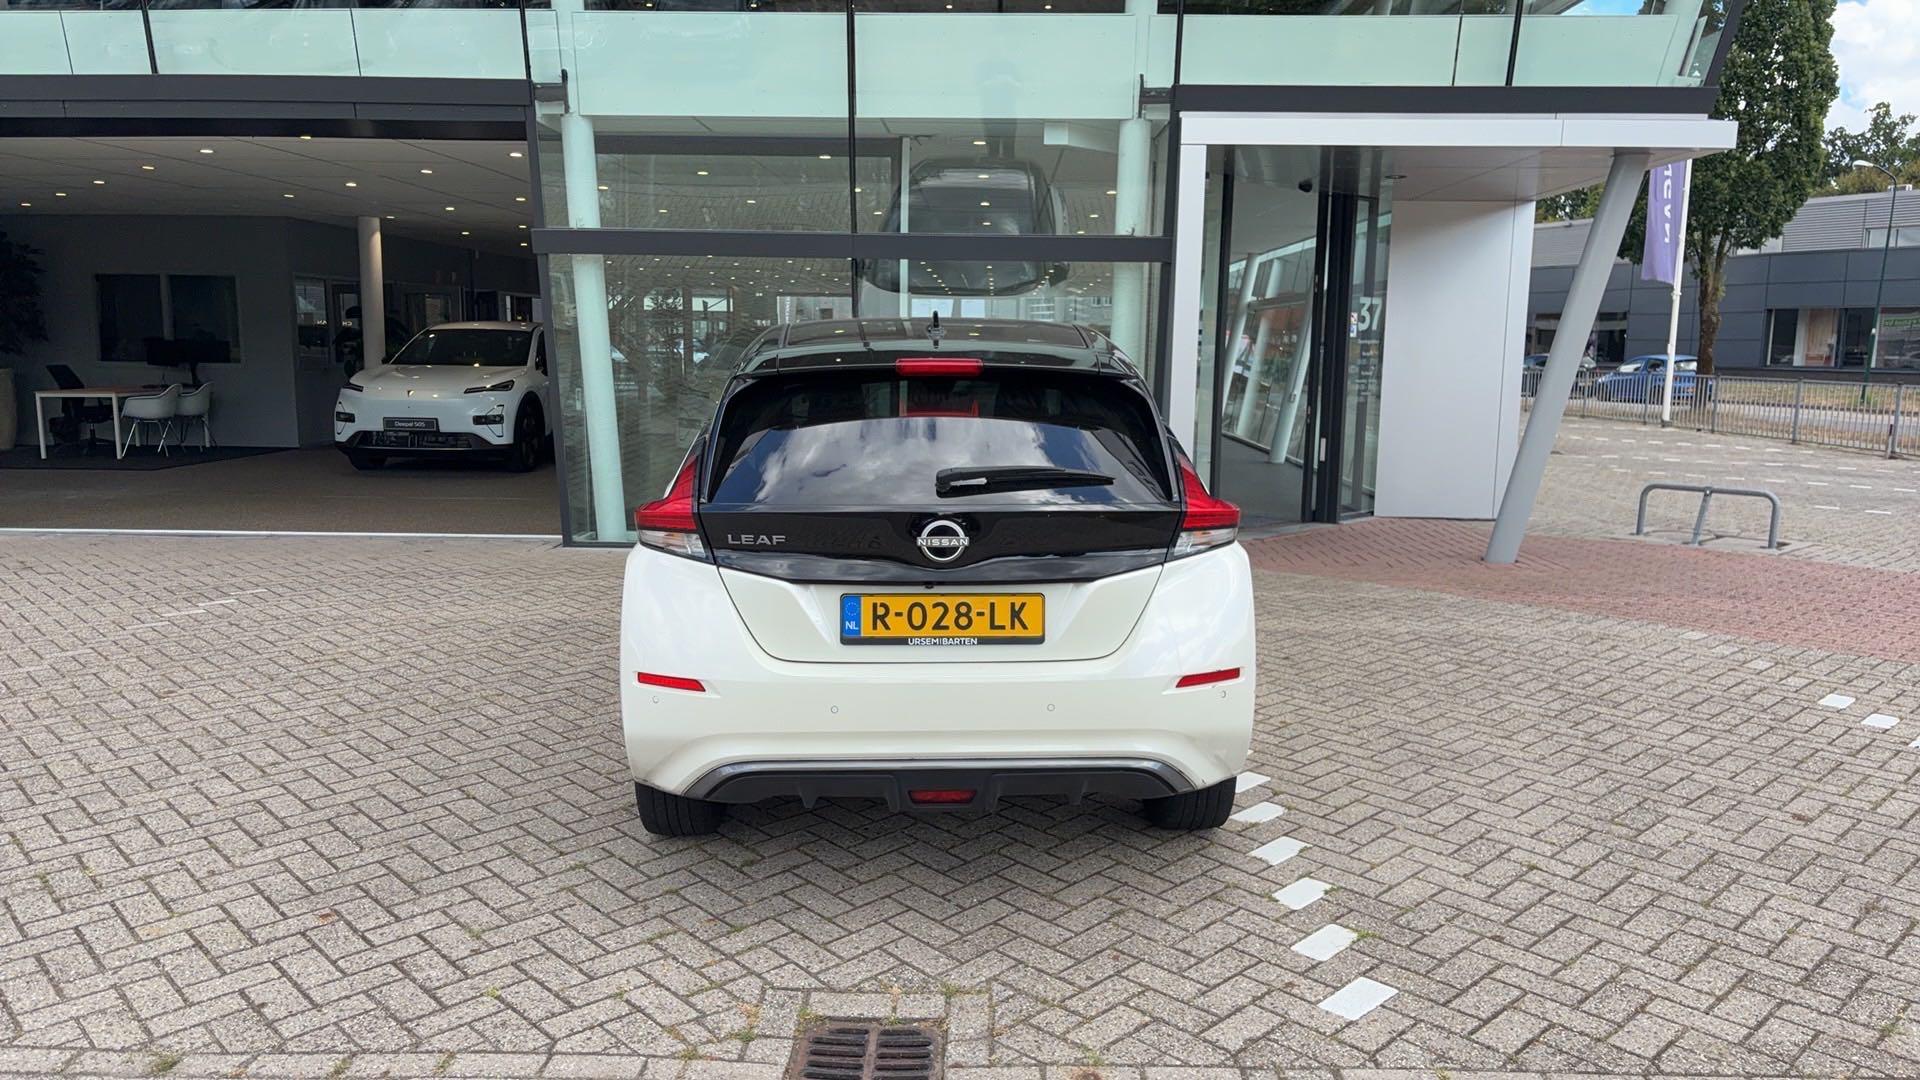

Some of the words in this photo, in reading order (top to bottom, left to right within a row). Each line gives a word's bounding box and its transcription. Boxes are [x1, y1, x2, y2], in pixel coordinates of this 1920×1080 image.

[1358, 297, 1382, 331] 37
[727, 534, 786, 545] LEAF
[917, 537, 968, 546] NISSAN
[872, 602, 1029, 631] R-028-LK
[845, 621, 859, 630] NL
